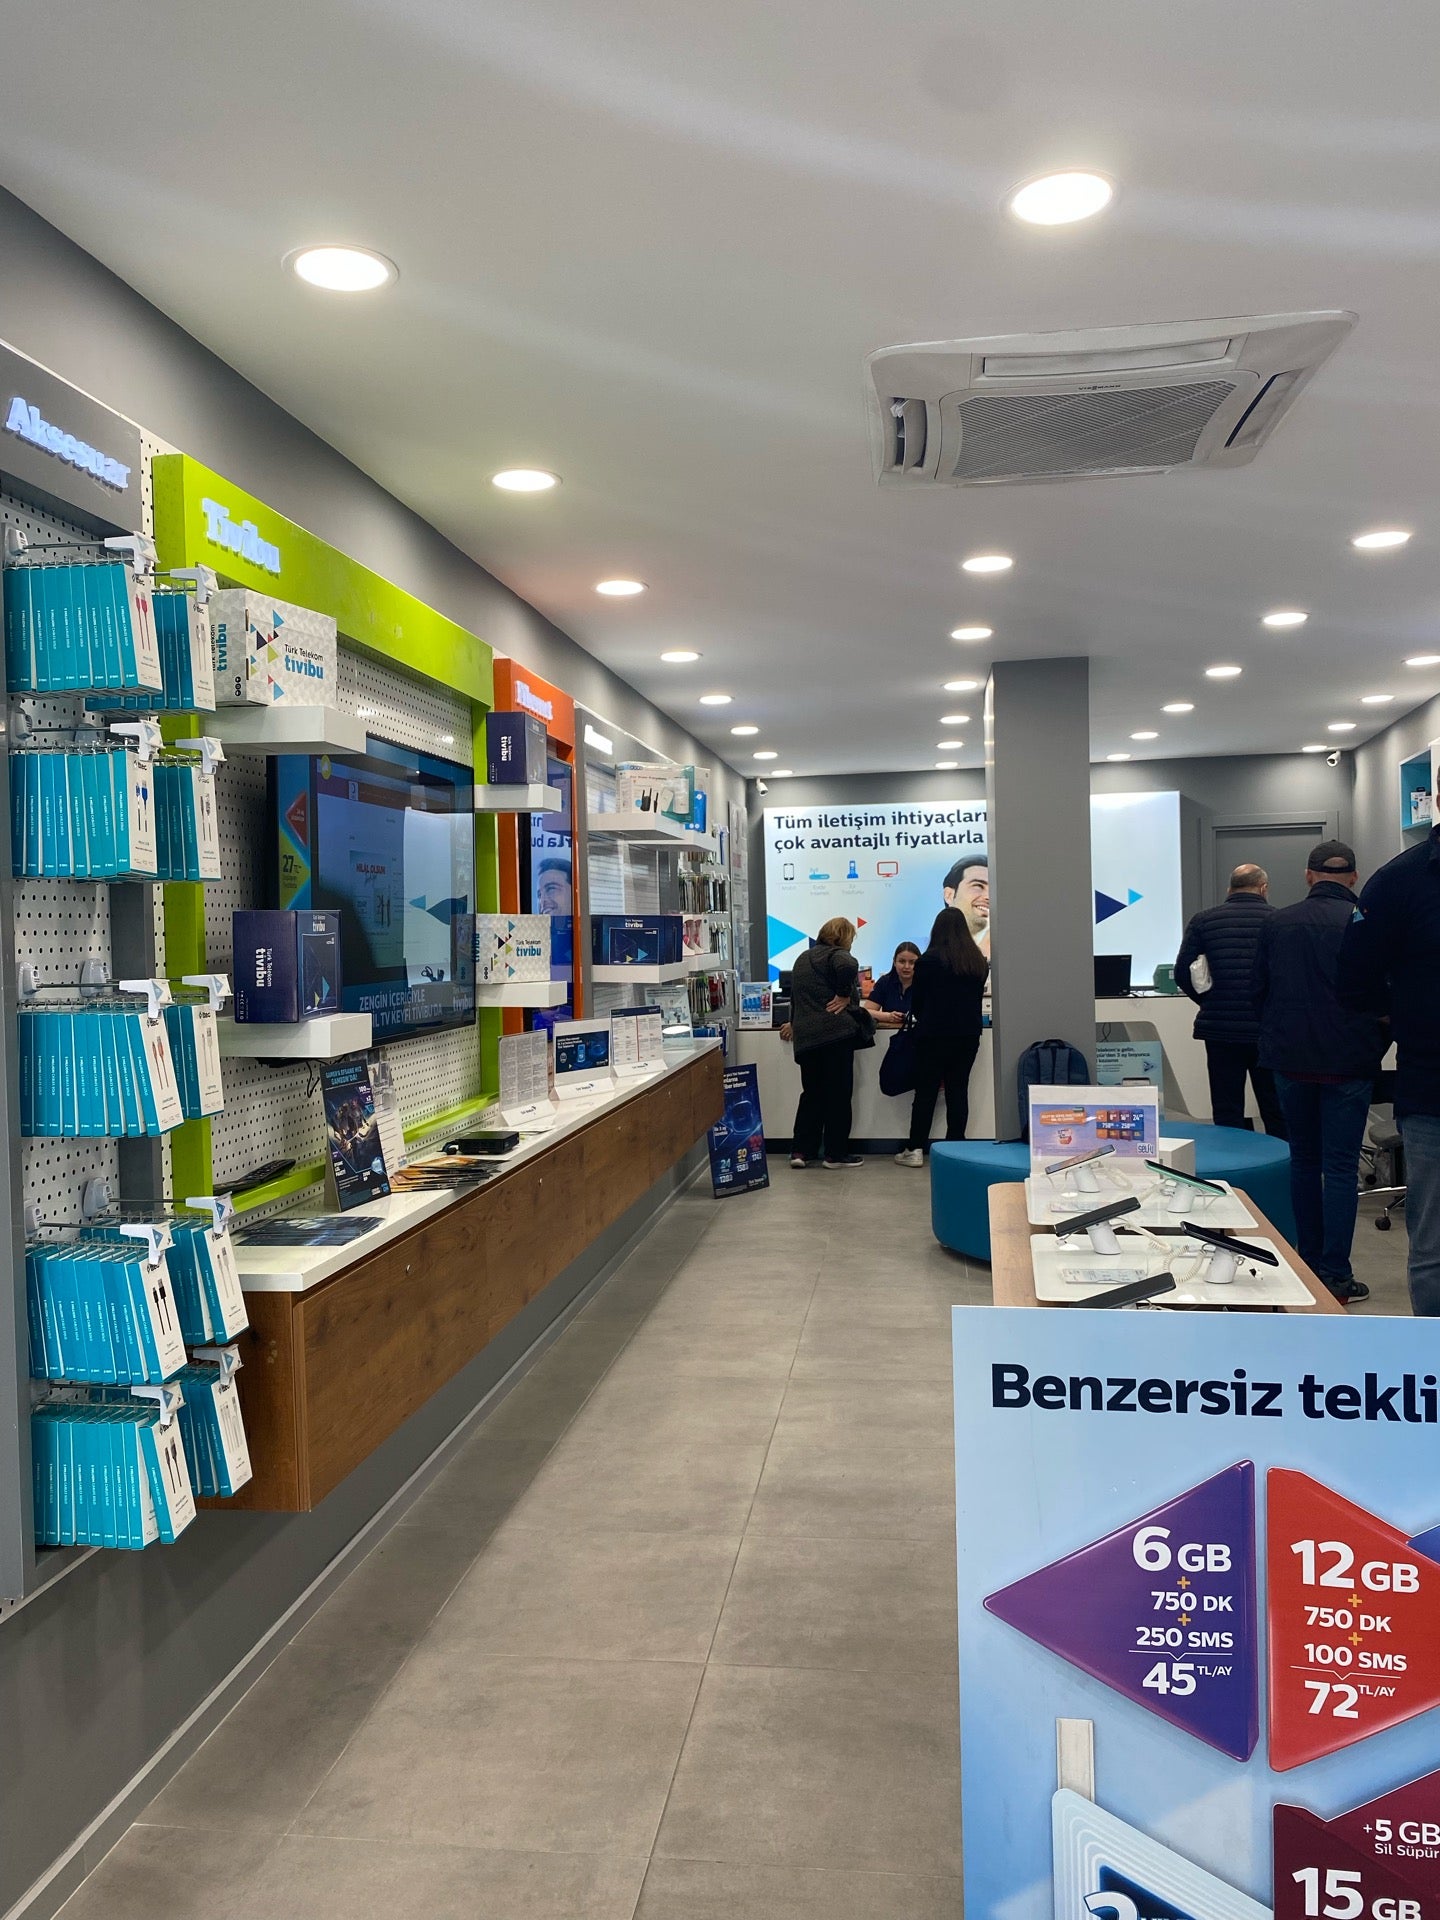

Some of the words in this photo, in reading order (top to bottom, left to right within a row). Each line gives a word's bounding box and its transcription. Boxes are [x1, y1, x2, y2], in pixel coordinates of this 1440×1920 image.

[202, 497, 281, 573] Tivibu
[284, 643, 298, 655] Türk
[299, 647, 324, 661] Telekom
[284, 655, 324, 679] tivibu
[774, 815, 812, 829] Tüm
[817, 812, 886, 830] iletişim
[774, 836, 805, 853] çok
[810, 833, 890, 850] avantajlı
[895, 830, 984, 848] fiyatlarla
[516, 946, 541, 957] tivibu
[256, 948, 266, 987] tivibu
[360, 992, 388, 1011] ZENGİN
[380, 1011, 391, 1025] TV
[391, 1005, 411, 1024] KEYFİ
[992, 1363, 1283, 1417] Benzersiz
[1133, 1526, 1172, 1571] 6
[1177, 1543, 1232, 1573] GB
[1290, 1540, 1355, 1589] 12
[1361, 1561, 1420, 1593] GB
[1151, 1591, 1197, 1612] 750
[1203, 1596, 1233, 1612] DK
[1304, 1606, 1354, 1630] 750
[1360, 1615, 1392, 1633] DK
[1136, 1627, 1183, 1647] 250
[1188, 1632, 1234, 1648] SMS
[1304, 1643, 1353, 1667] 100
[1358, 1652, 1408, 1671] SMS
[1142, 1662, 1197, 1696] 45
[1197, 1665, 1233, 1678] TL/AY
[1304, 1680, 1359, 1719] 72
[1358, 1684, 1396, 1697] TL/AY
[1399, 1821, 1440, 1846] GB
[1374, 1843, 1393, 1855] Sil
[1396, 1845, 1440, 1859] Süpür
[1292, 1867, 1364, 1920] 15
[1371, 1898, 1422, 1920] GB
